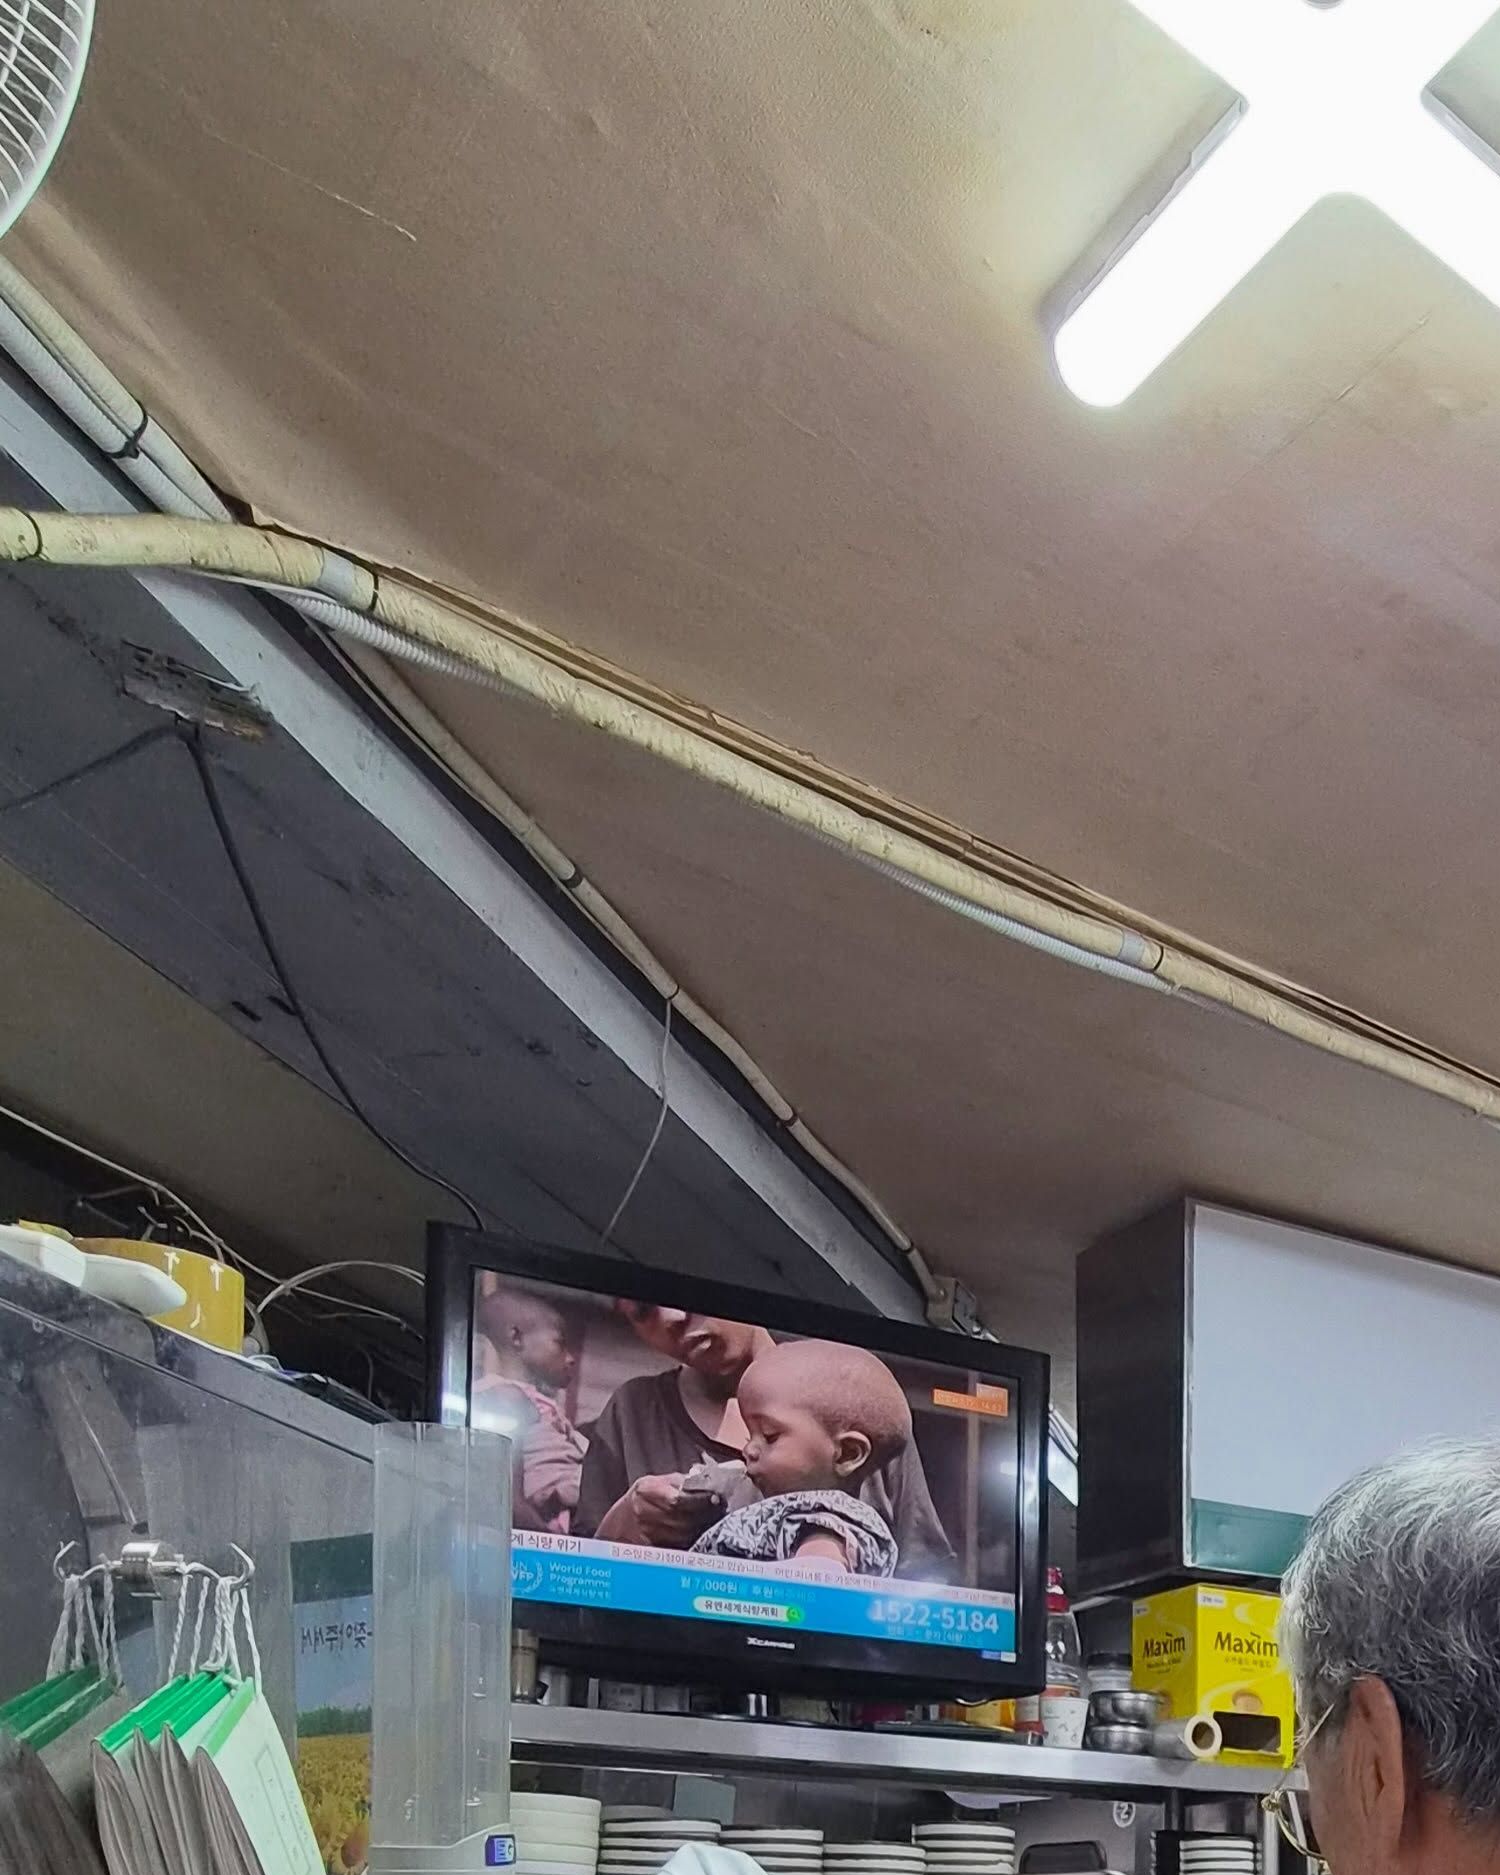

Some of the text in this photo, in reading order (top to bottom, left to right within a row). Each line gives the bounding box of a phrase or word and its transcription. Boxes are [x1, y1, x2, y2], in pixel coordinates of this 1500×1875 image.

[557, 1539, 581, 1553] 위기
[549, 1561, 612, 1578] World Food
[871, 1599, 1000, 1635] 1522-5184
[1142, 1631, 1186, 1660] Maxim
[1214, 1631, 1279, 1657] Maxim
